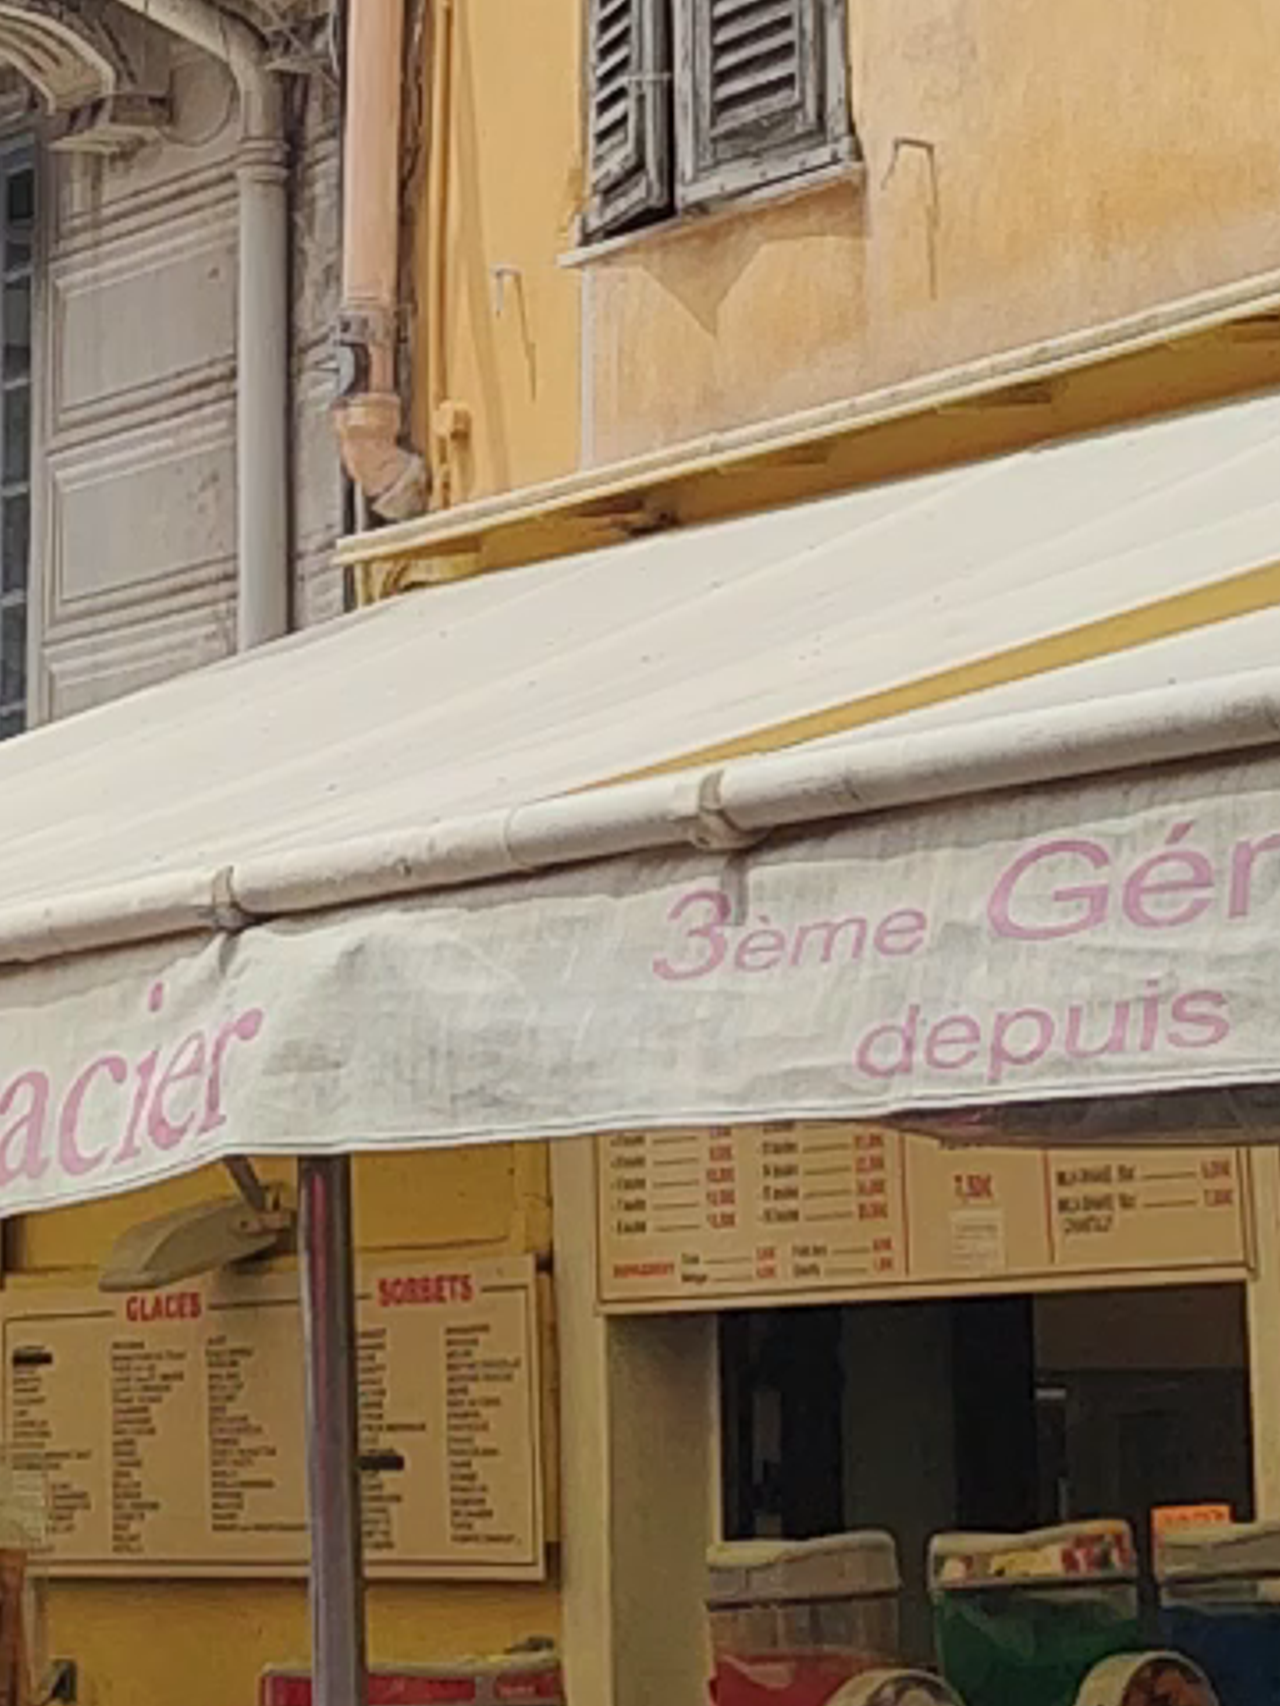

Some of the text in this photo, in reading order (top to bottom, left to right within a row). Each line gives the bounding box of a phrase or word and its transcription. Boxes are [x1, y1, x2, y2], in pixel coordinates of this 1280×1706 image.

[651, 888, 928, 981] 3ème
[851, 978, 1233, 1084] depuis
[126, 1291, 202, 1322] GLACES
[377, 1273, 475, 1308] SORBETS
